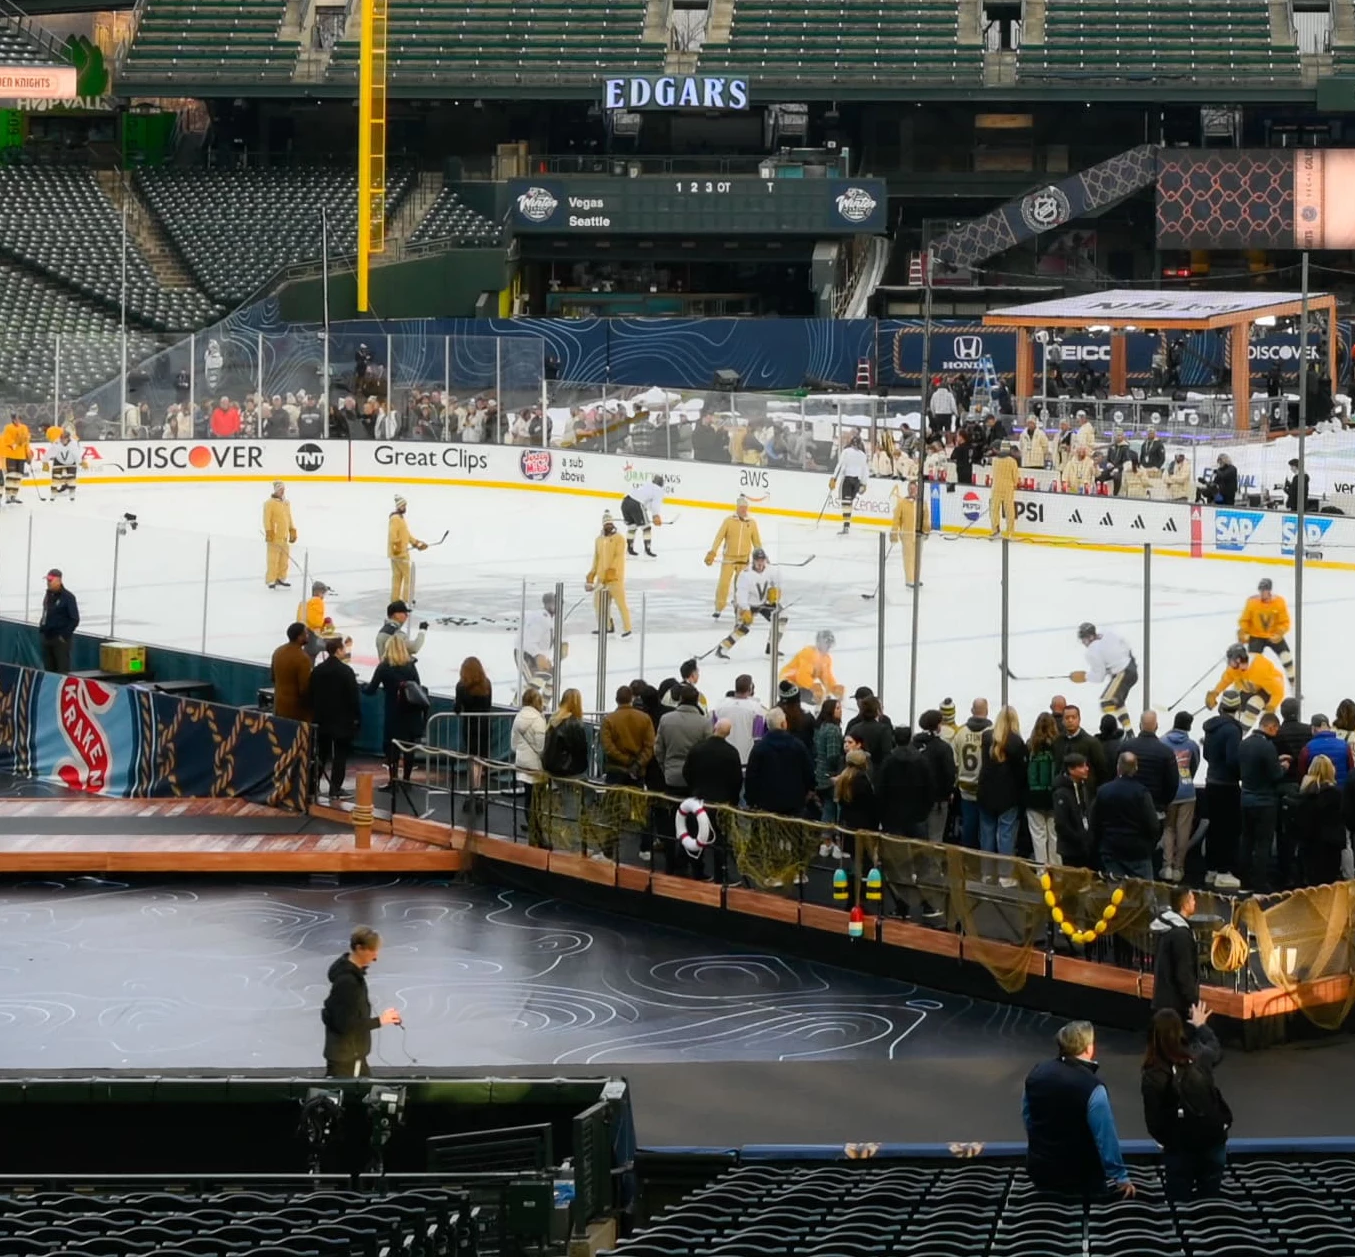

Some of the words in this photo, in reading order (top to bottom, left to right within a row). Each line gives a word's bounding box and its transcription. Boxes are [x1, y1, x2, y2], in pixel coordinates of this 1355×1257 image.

[15, 77, 50, 87] KNIGHTS
[605, 77, 748, 109] EDGAR'S
[676, 183, 681, 192] 1
[691, 183, 698, 192] 2
[706, 183, 712, 192] 3
[717, 183, 731, 192] OT
[767, 183, 774, 192] T
[569, 197, 603, 210] Vegas
[569, 216, 610, 226] Seattle
[127, 445, 264, 469] DISCOVER
[297, 452, 323, 465] TNT
[375, 445, 436, 466] Great
[443, 447, 487, 474] Clips
[523, 450, 551, 463] Jersey
[562, 460, 567, 468] a
[569, 458, 583, 469] sub
[561, 472, 585, 482] above
[741, 469, 769, 488] aws
[1216, 514, 1252, 542] SAP
[1282, 519, 1324, 547] SP
[64, 684, 105, 787] KRAKEN
